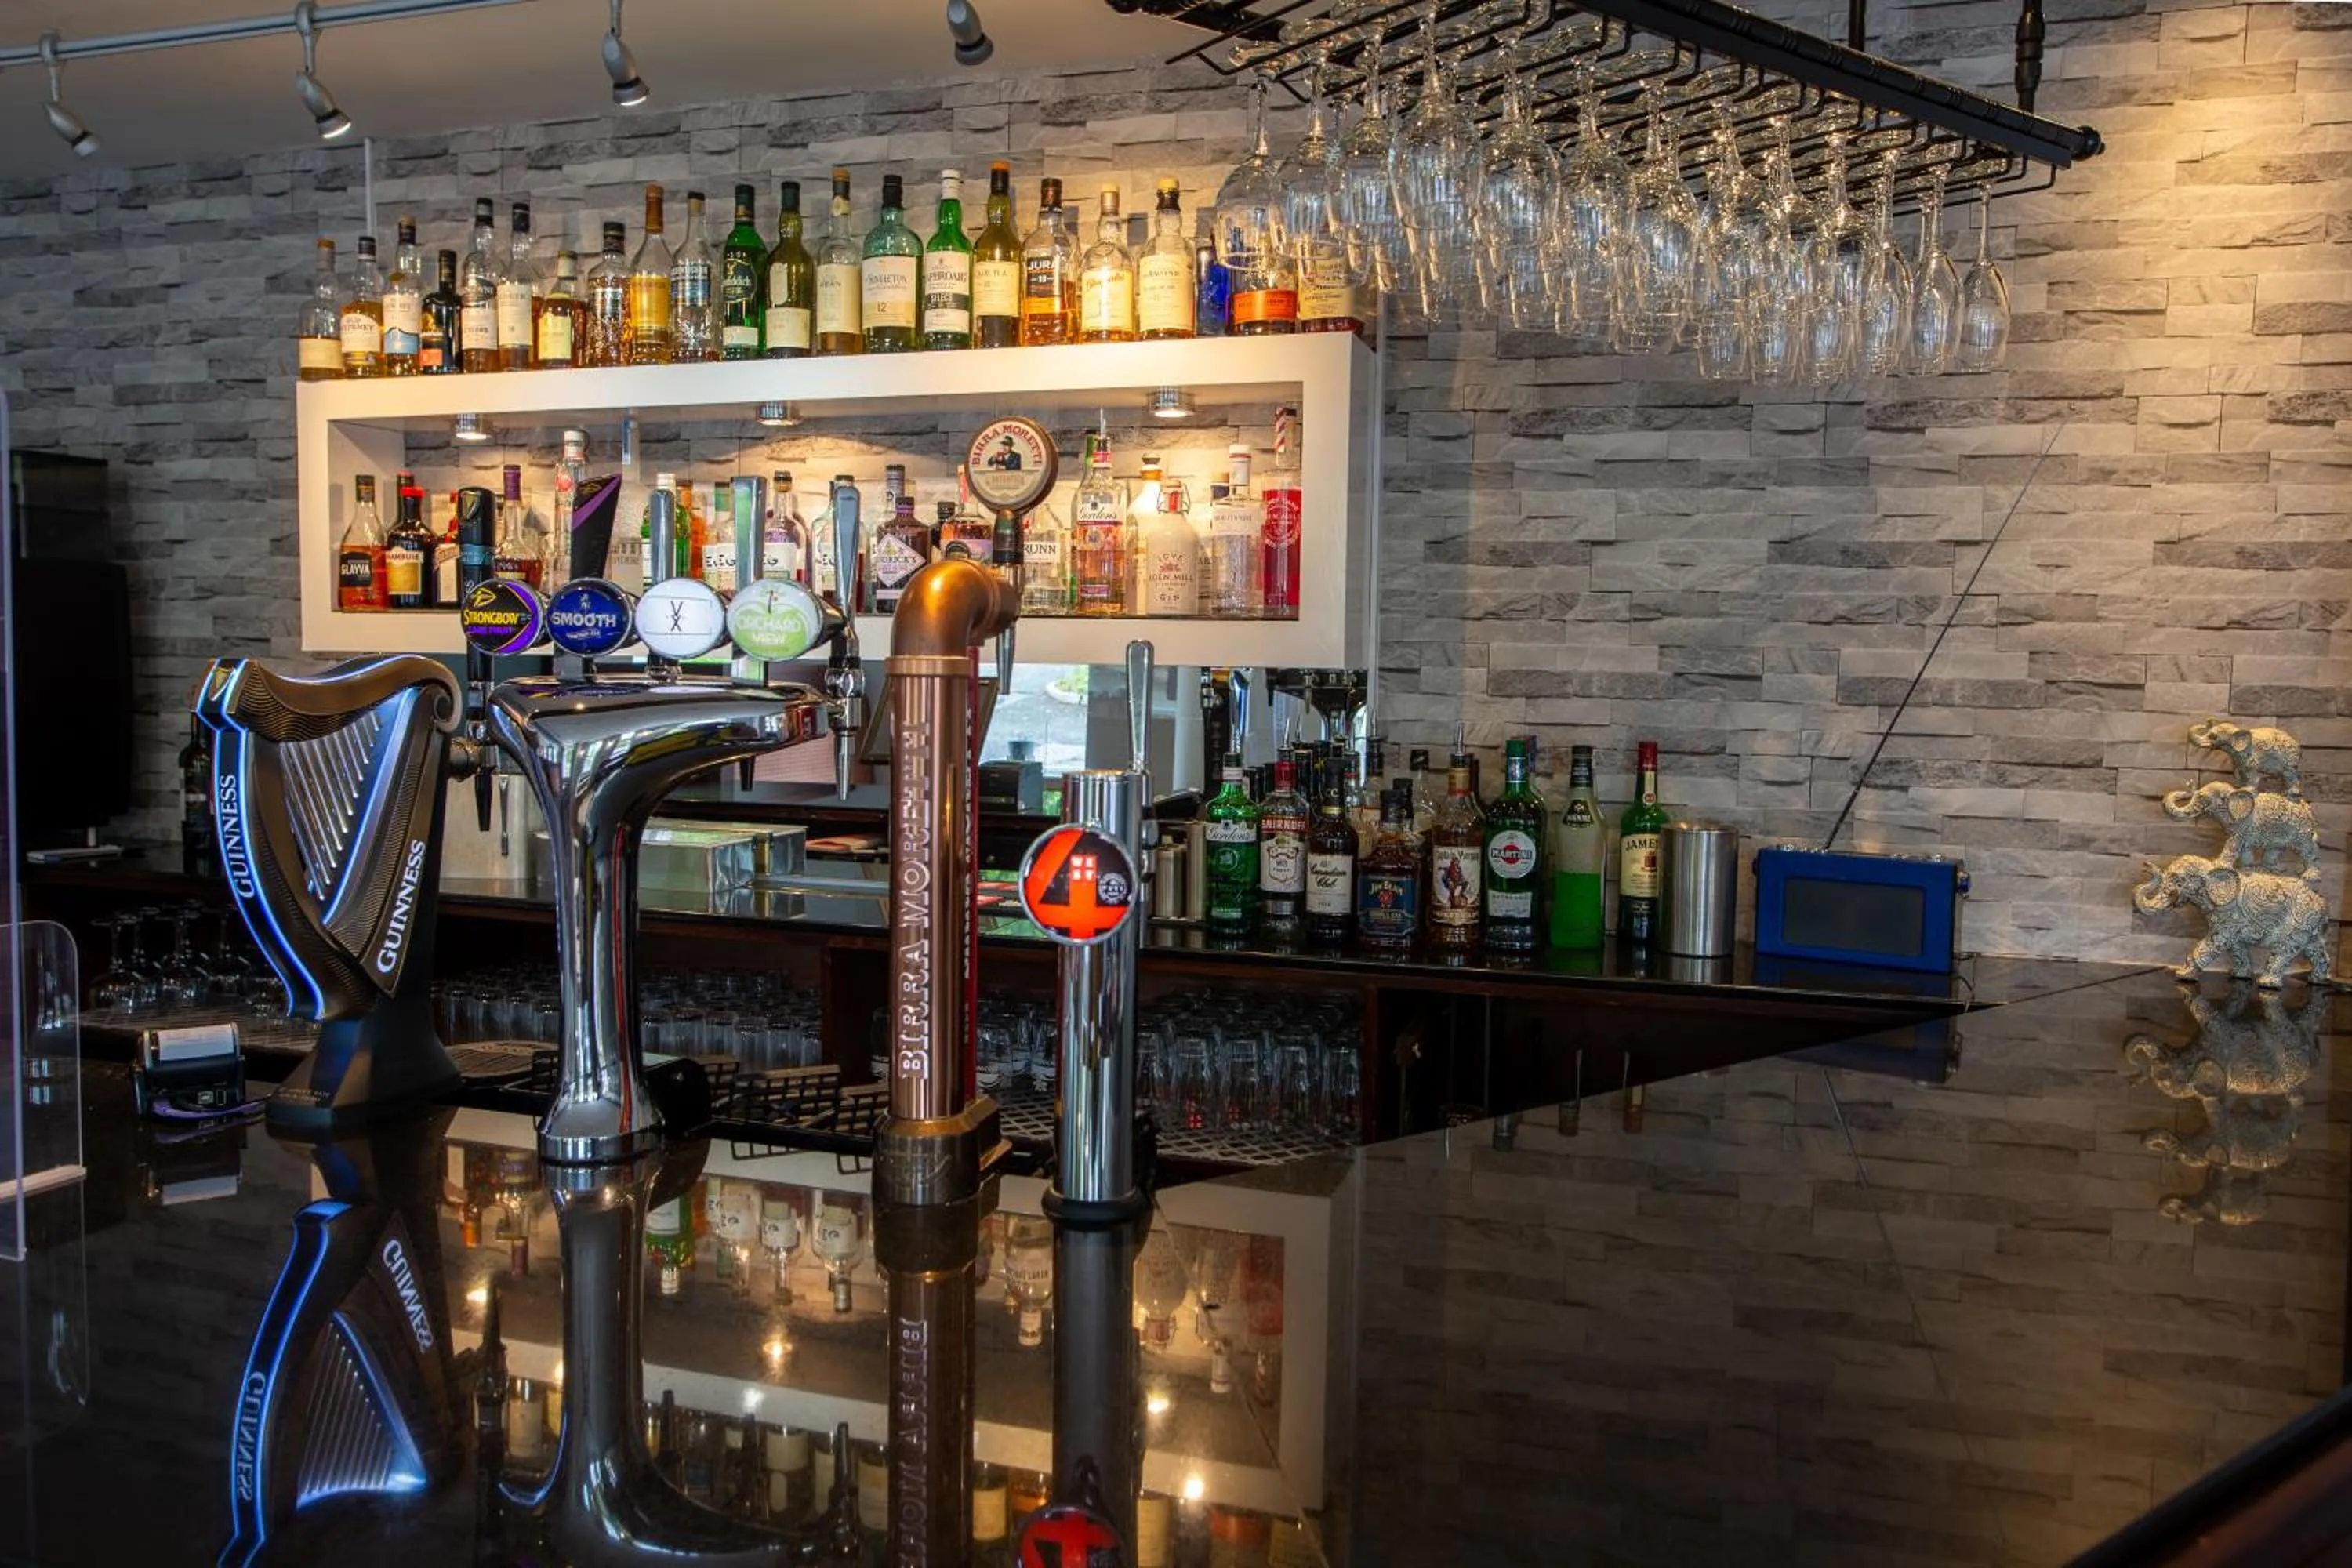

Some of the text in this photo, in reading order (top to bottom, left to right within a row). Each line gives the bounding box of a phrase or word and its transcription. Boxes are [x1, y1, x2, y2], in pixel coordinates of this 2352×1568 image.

[877, 302, 887, 313] 12
[971, 424, 1042, 466] BIRRA MORETTI
[1023, 543, 1056, 554] RUNN
[463, 609, 520, 625] STRONGBOW
[551, 611, 616, 628] SMOOTH
[219, 772, 256, 899] GUINNESS
[1624, 838, 1659, 851] JAME
[376, 839, 426, 975] GUINNESS
[901, 939, 930, 1080] BIRRA
